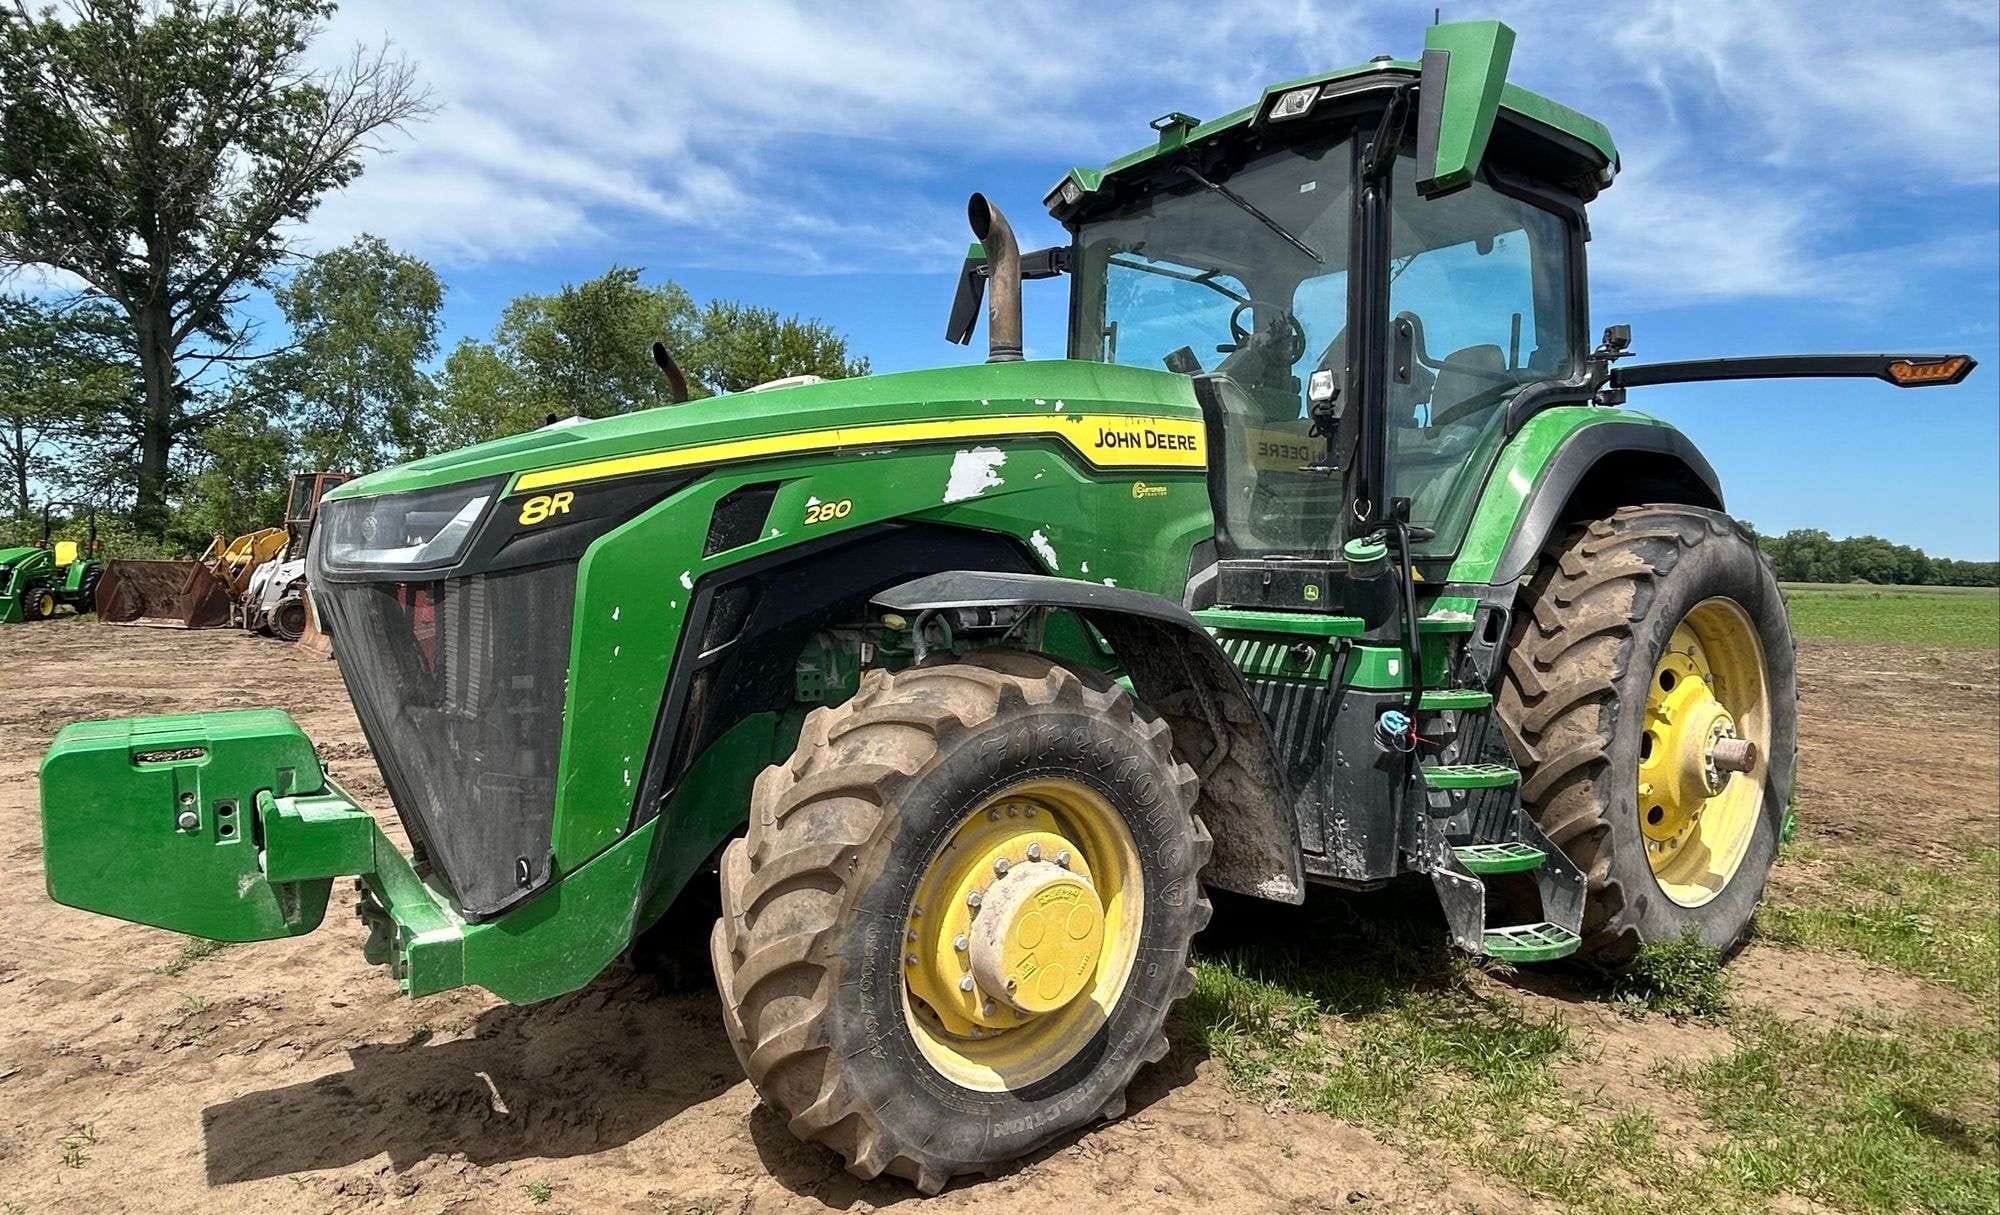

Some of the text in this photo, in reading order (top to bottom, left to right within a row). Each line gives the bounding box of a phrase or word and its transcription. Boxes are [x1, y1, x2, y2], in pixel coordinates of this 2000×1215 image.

[1094, 428, 1197, 451] JOHN DEERE
[518, 491, 574, 525] 8R
[803, 499, 852, 525] 280
